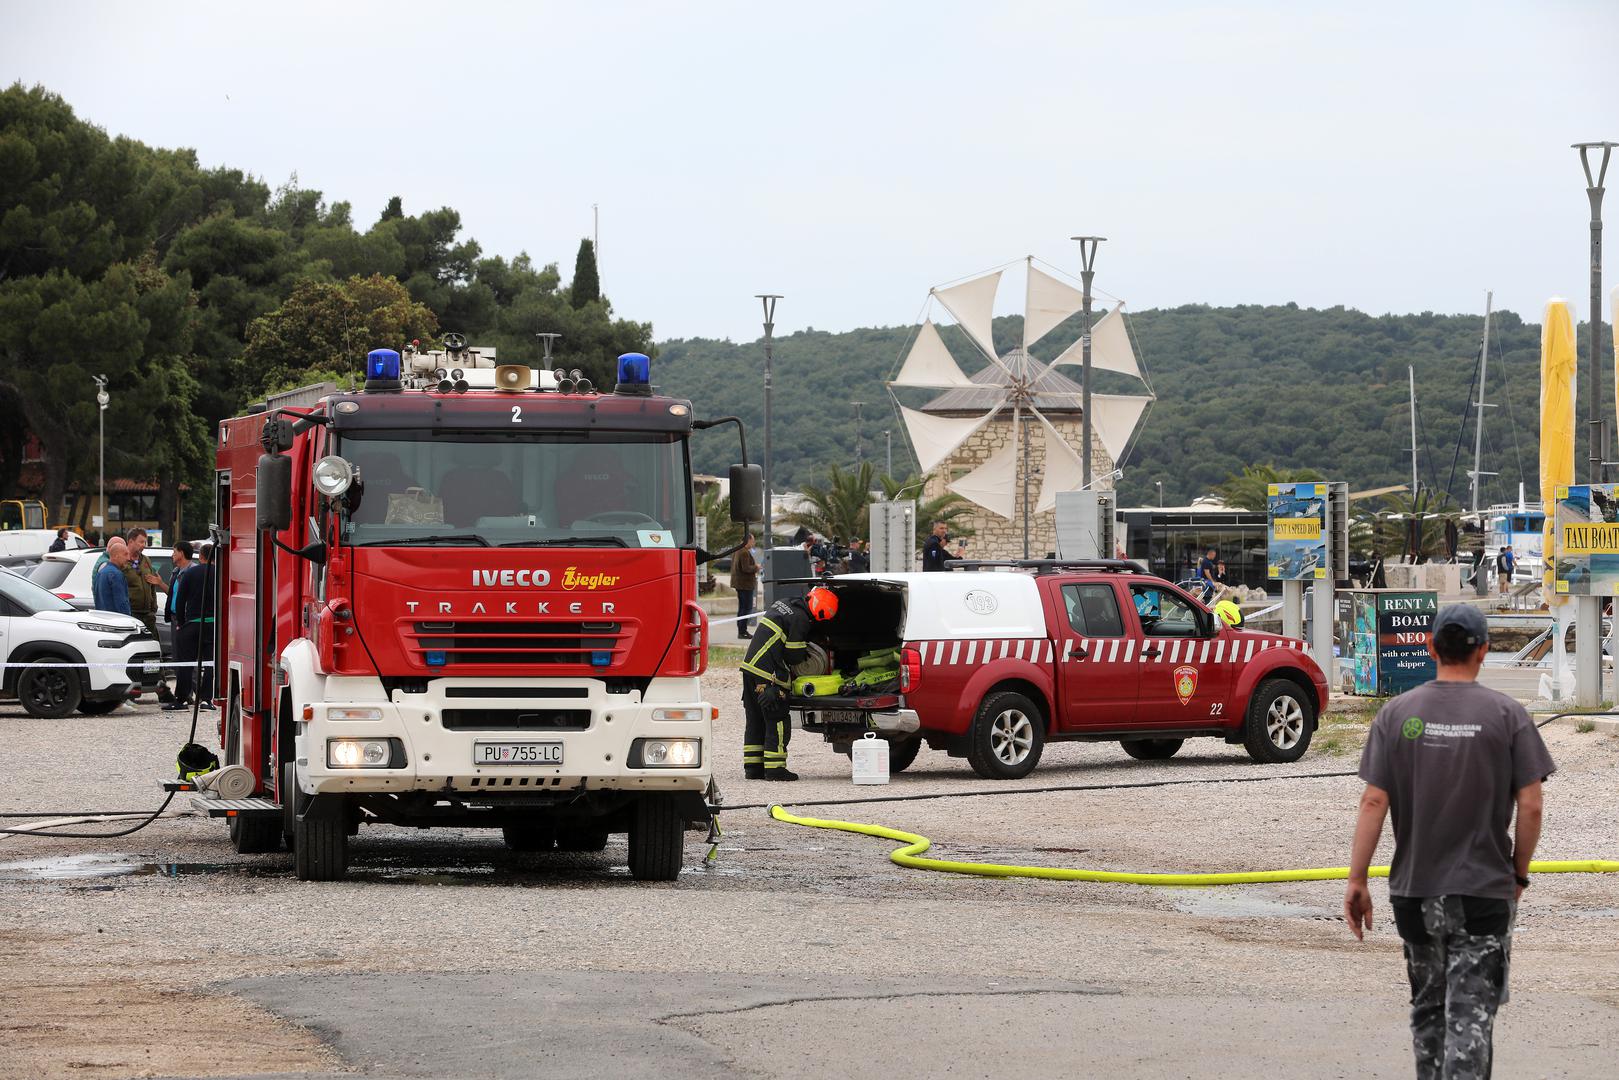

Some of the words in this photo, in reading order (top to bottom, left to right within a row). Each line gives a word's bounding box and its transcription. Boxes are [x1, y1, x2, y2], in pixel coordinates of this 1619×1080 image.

[511, 405, 522, 423] 2
[1275, 523, 1287, 534] RENT
[1292, 523, 1307, 534] SPEED
[1307, 523, 1320, 534] BOAT
[1565, 527, 1588, 549] TAXI
[472, 569, 550, 587] IVECO
[562, 566, 620, 590] Ziegler
[406, 602, 615, 614] TRAKKER
[1384, 598, 1423, 610] RENT
[1426, 598, 1436, 609] A
[1391, 614, 1430, 627] BOAT
[1396, 631, 1426, 644] NEO
[1381, 650, 1398, 658] with
[1396, 661, 1426, 669] skipper
[1210, 702, 1223, 715] 22
[1425, 722, 1450, 730] ANGLO
[1424, 729, 1475, 737] CORPORATION
[485, 747, 501, 760] PU
[511, 746, 560, 761] 755-LC
